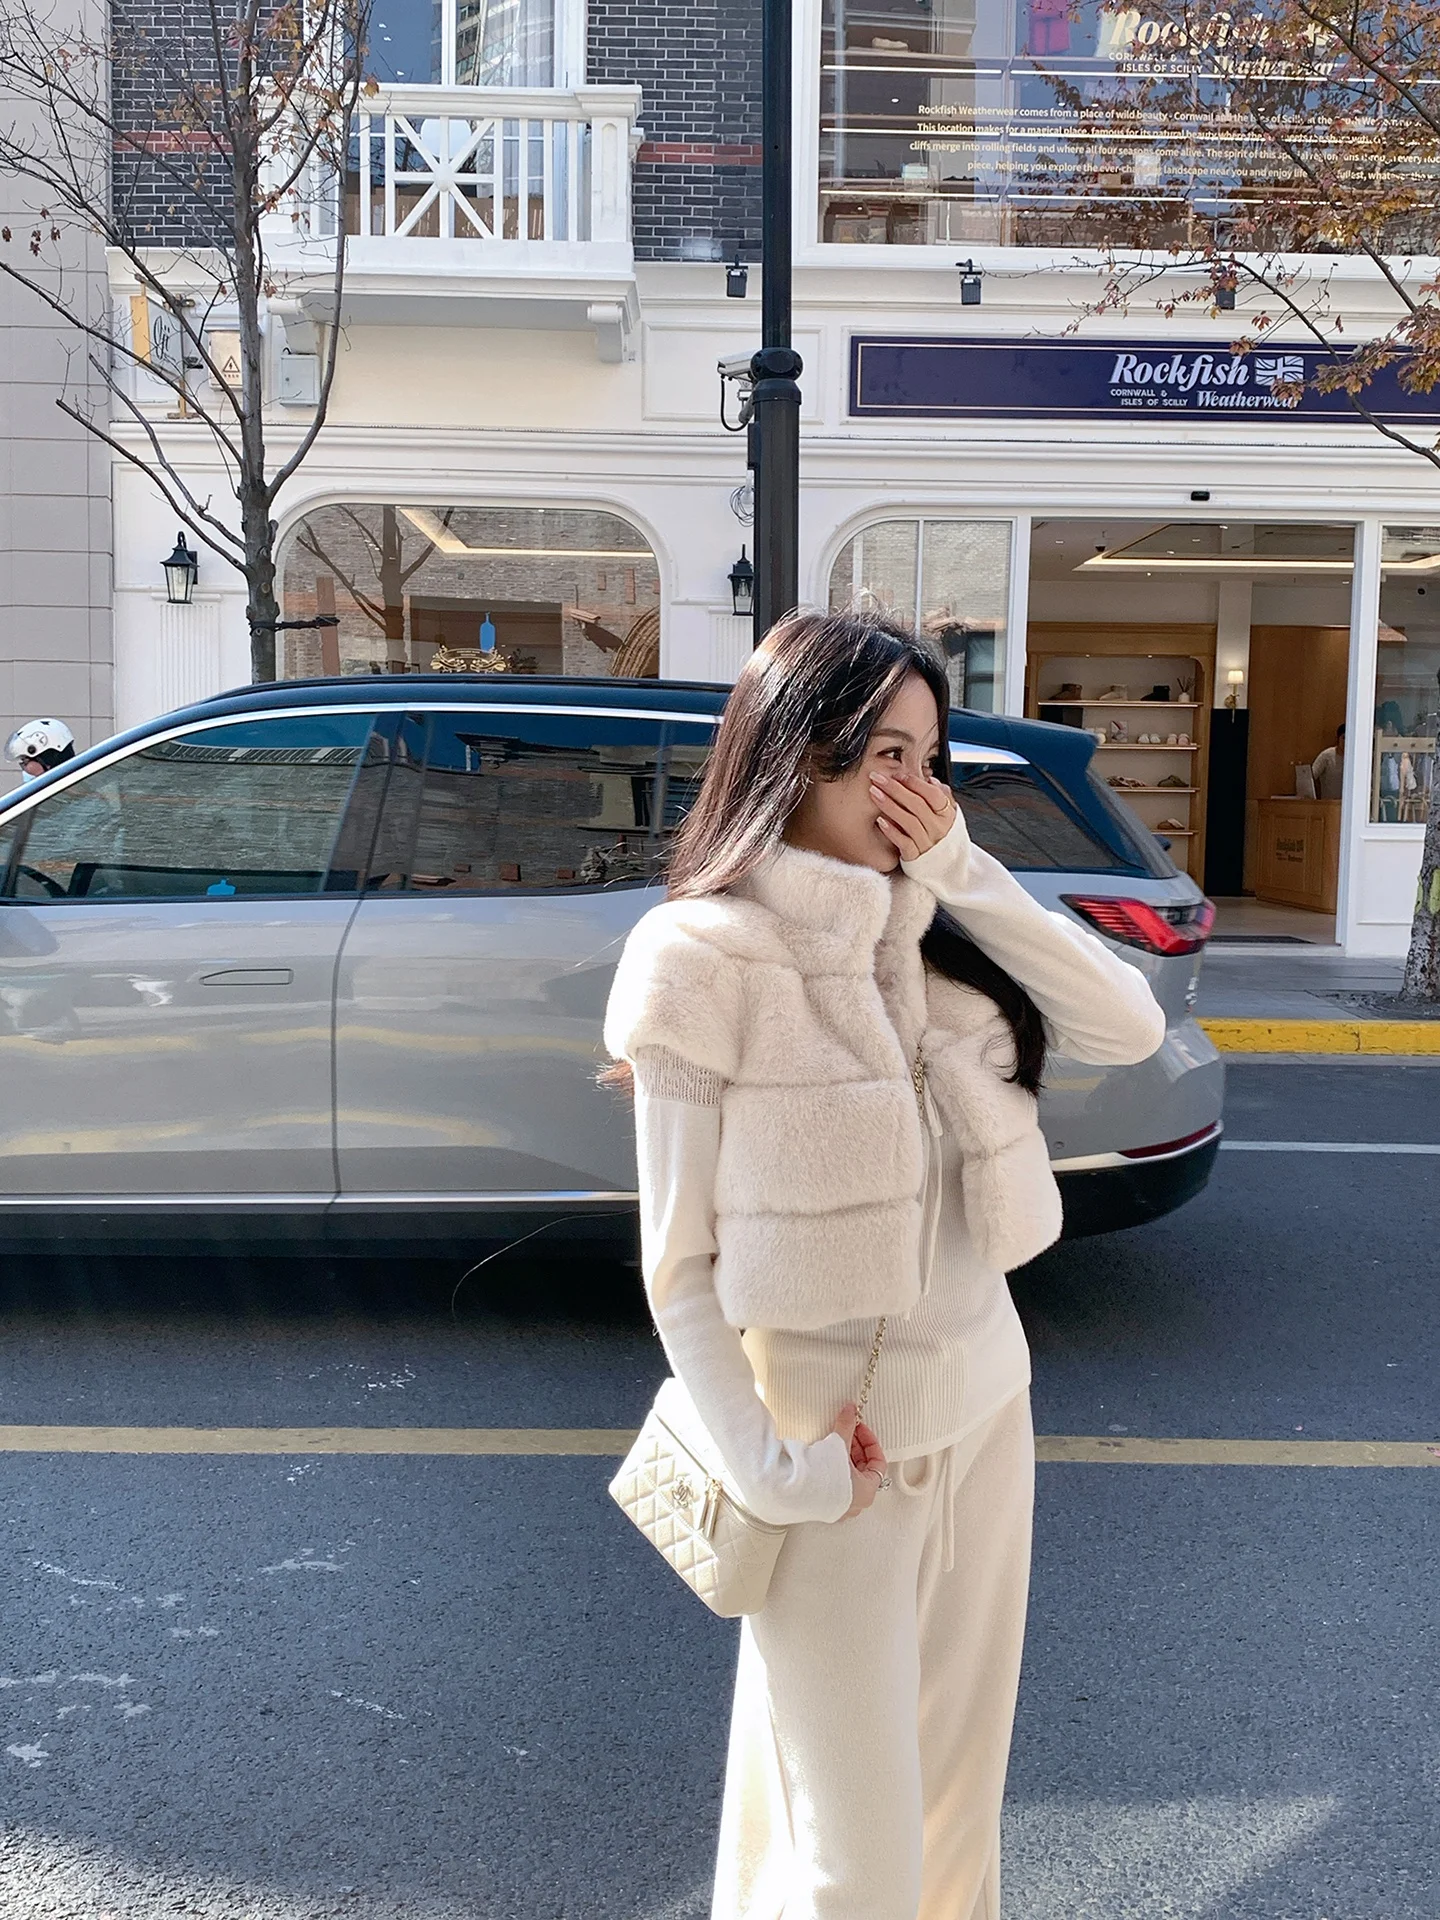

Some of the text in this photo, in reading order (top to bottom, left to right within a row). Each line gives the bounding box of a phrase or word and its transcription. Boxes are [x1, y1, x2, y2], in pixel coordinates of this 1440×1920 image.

[1123, 63, 1203, 74] ISLES OF SCILLY
[918, 105, 957, 115] Rockfish
[959, 106, 1017, 116] Weatherwear
[1020, 108, 1048, 117] comes
[1050, 108, 1071, 117] from
[1080, 109, 1104, 120] place
[1105, 109, 1115, 119] of
[1116, 110, 1135, 119] wild
[1137, 110, 1168, 121] beauty
[1233, 113, 1248, 122] the
[1250, 113, 1269, 123] Ies
[1271, 114, 1281, 122] of
[1318, 115, 1333, 124] the
[917, 122, 936, 133] This
[938, 123, 974, 133] location
[975, 124, 1004, 134] makes
[1006, 125, 1019, 134] for
[1027, 126, 1062, 137] magical
[1091, 127, 1124, 137] famous
[1126, 128, 1139, 137] for
[1140, 128, 1151, 137] its
[1153, 129, 1184, 139] natural
[909, 141, 931, 151] cliffs
[932, 143, 961, 153] merge
[962, 142, 980, 152] into
[981, 142, 1010, 154] rolling
[1012, 143, 1037, 153] fields
[1038, 144, 1055, 153] and
[1056, 145, 1085, 154] where
[1086, 145, 1097, 155] all
[1098, 145, 1117, 155] four
[1119, 147, 1154, 156] seasons
[1155, 148, 1179, 157] come
[1180, 147, 1204, 157] alive.
[1206, 148, 1222, 158] The
[1224, 149, 1247, 159] spirit
[1248, 149, 1258, 158] of
[1260, 149, 1276, 159] this
[1277, 151, 1308, 161] speial
[1397, 154, 1422, 165] every
[967, 161, 994, 171] piece,
[995, 160, 1029, 173] helping
[1030, 163, 1047, 173] you
[1049, 162, 1082, 173] explore
[1083, 163, 1098, 172] the
[1163, 165, 1208, 177] landscape
[1210, 168, 1230, 176] near
[1231, 168, 1248, 178] you
[1249, 167, 1267, 177] and
[1268, 168, 1293, 180] enjoy
[1294, 168, 1308, 178] life
[1108, 354, 1250, 392] Rockfish
[1110, 388, 1168, 397] CORNWALL &
[1121, 398, 1189, 407] ISLES OF SCILLY
